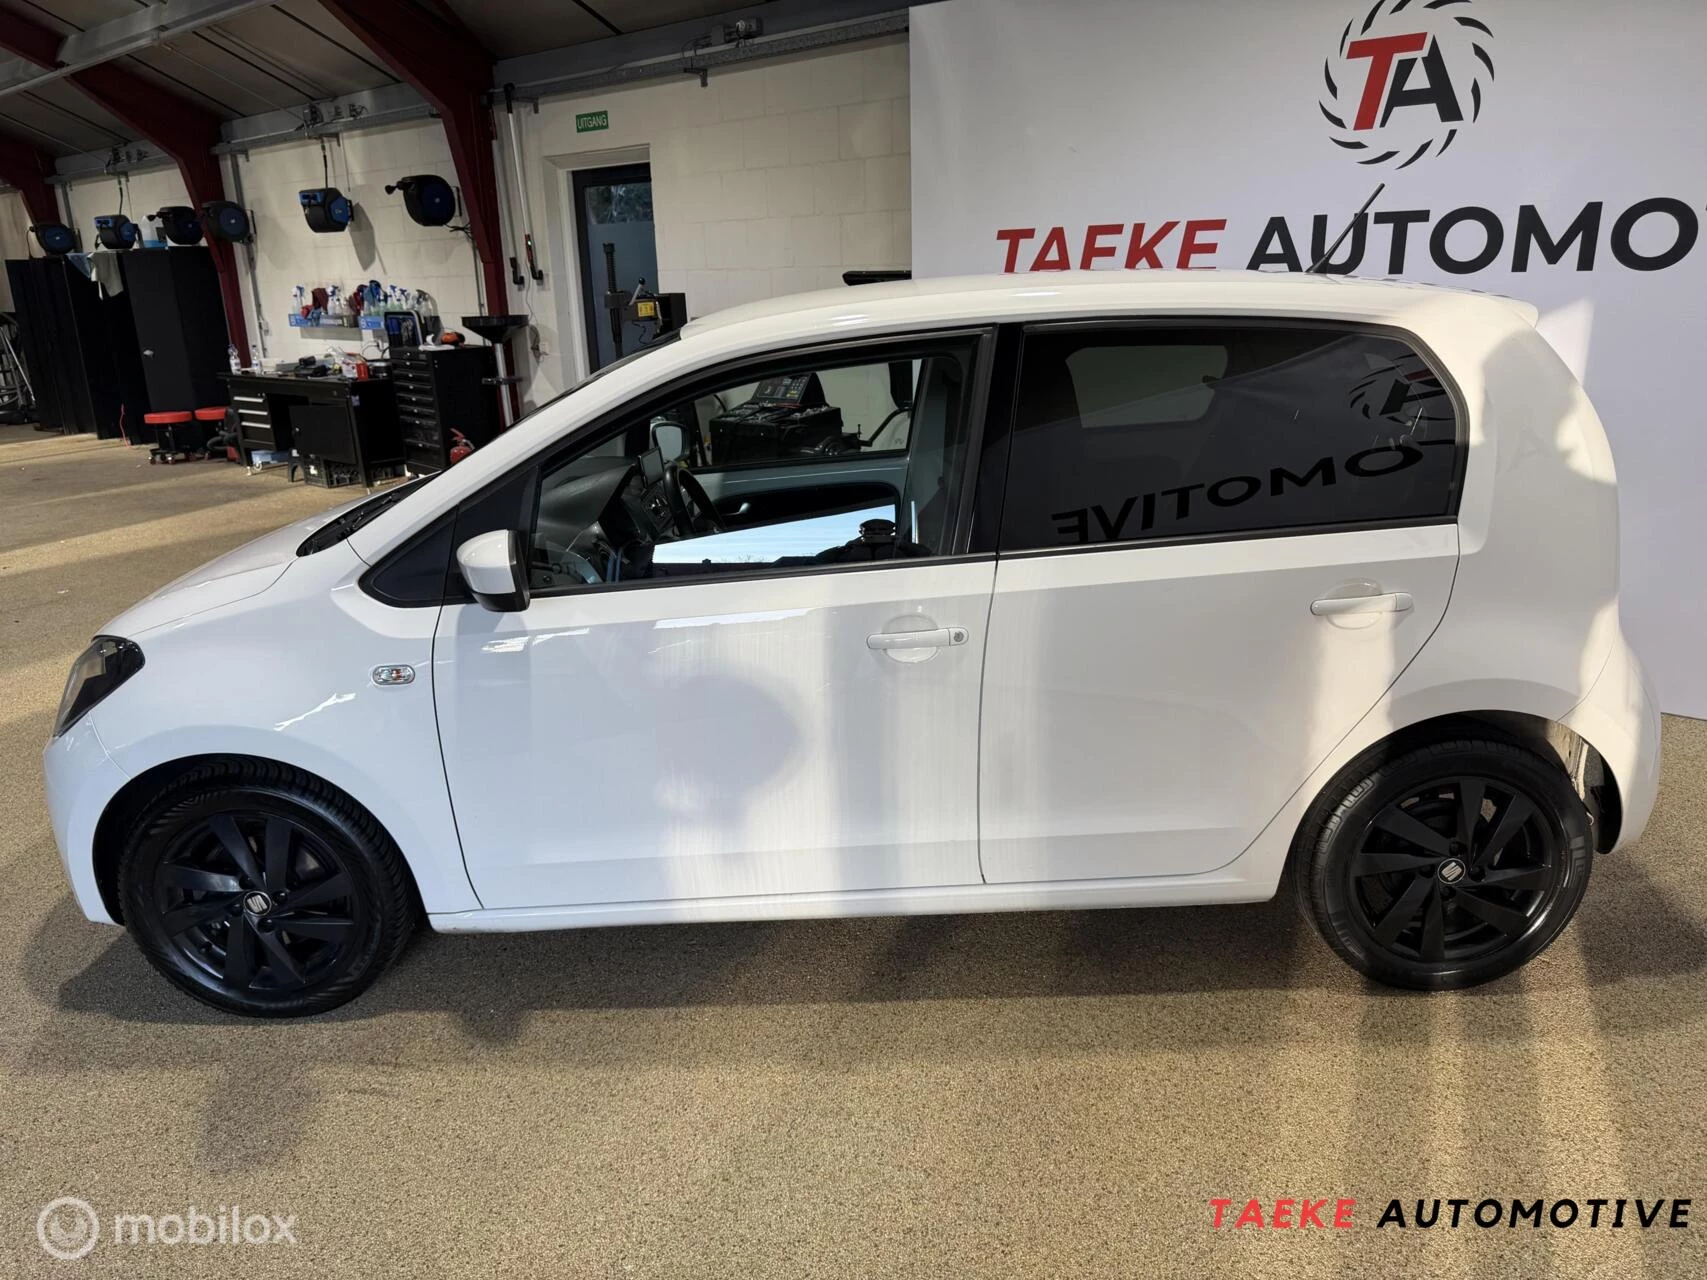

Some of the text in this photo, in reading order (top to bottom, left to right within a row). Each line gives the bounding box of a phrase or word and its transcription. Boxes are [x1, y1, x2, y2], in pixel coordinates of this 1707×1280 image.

[1347, 32, 1464, 131] TA
[577, 114, 607, 129] UITGANG
[1246, 197, 1707, 275] AUTOMO
